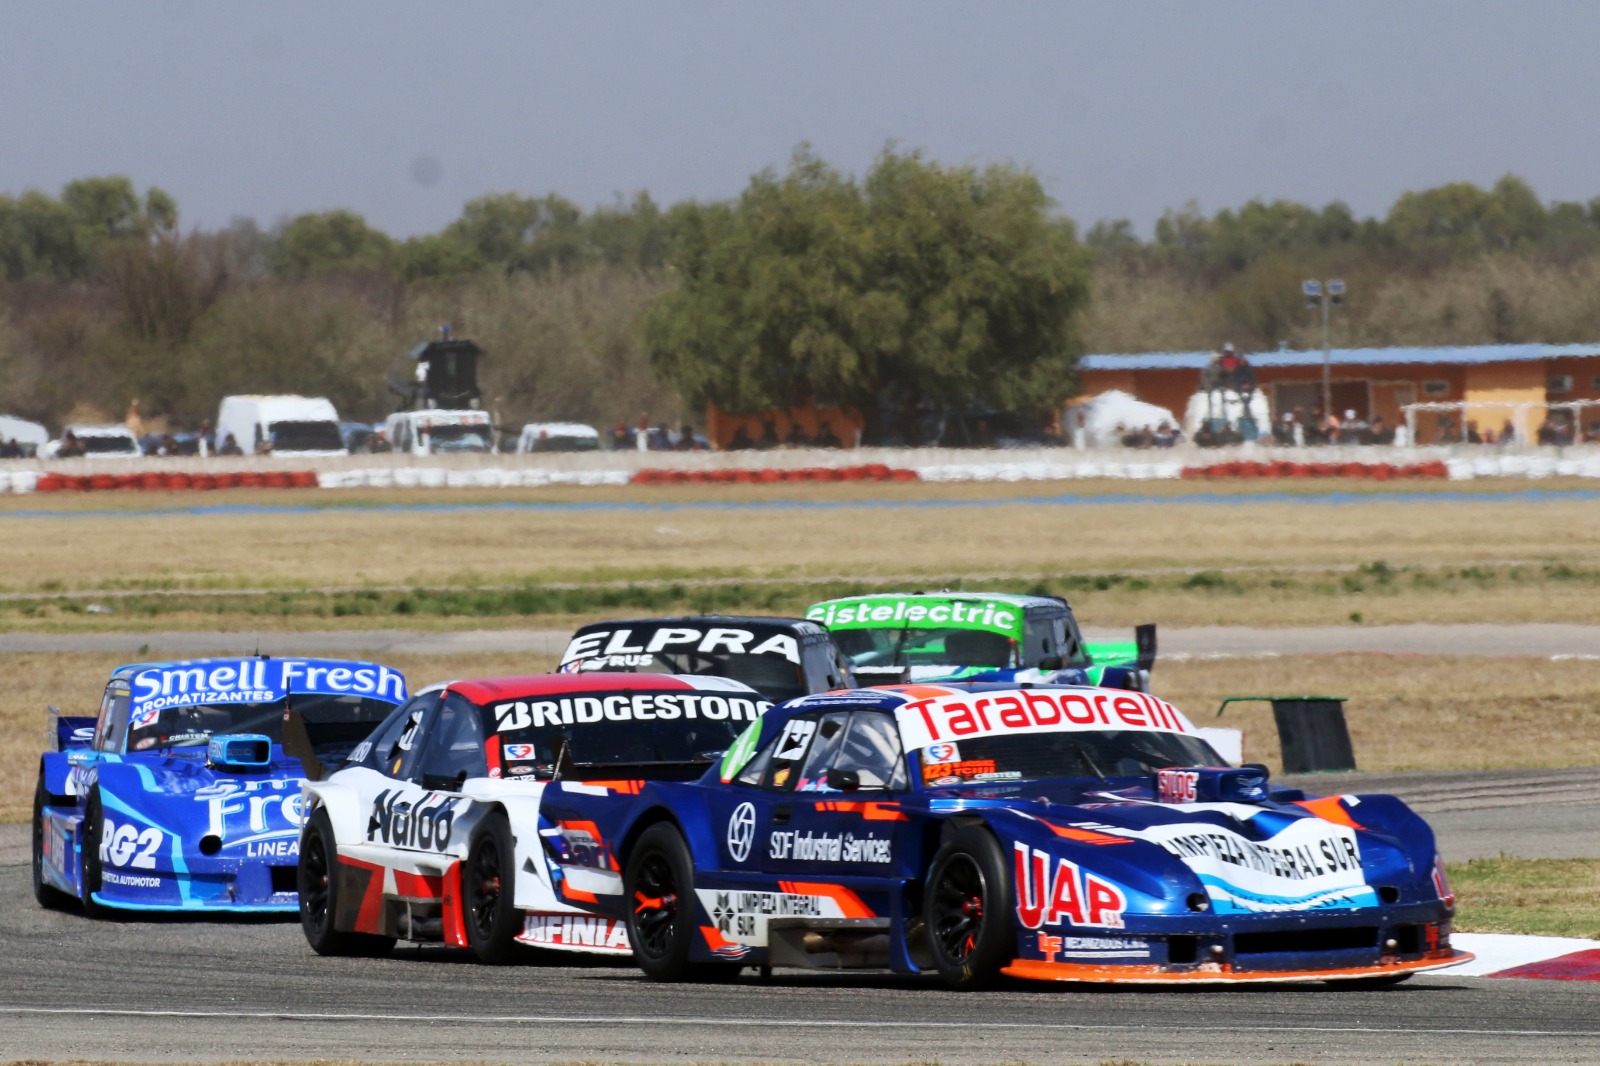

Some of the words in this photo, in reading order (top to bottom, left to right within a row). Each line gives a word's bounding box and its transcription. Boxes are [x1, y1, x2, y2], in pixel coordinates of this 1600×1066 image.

[560, 627, 800, 666] ELPRA
[133, 660, 269, 703] Smell
[281, 661, 405, 701] Fresh
[131, 690, 275, 720] AROMATIZANTES
[904, 689, 1185, 741] Taraborelli
[99, 817, 164, 870] RG2
[792, 829, 844, 862] Industrial
[842, 831, 892, 864] Services
[1319, 836, 1362, 873] SUR
[1013, 839, 1128, 930] UAP
[518, 914, 632, 950] INFINIA
